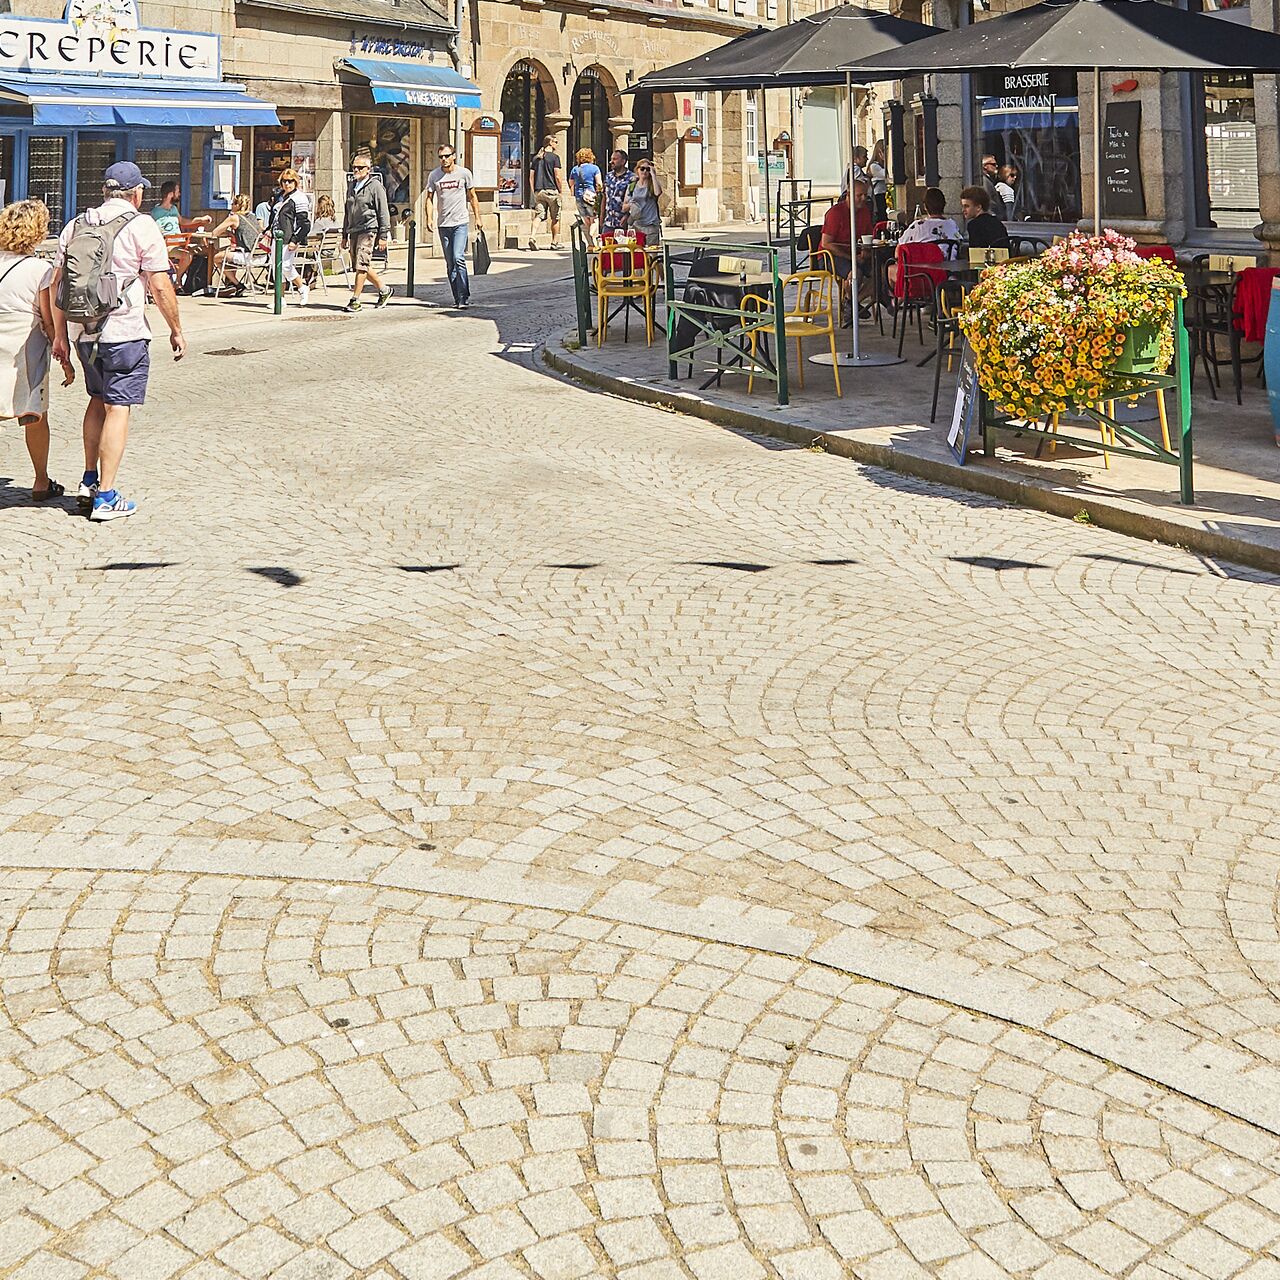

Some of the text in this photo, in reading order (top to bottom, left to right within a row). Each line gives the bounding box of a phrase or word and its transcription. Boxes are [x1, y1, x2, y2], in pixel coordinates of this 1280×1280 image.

[571, 29, 621, 57] Restaurant
[1004, 72, 1050, 90] BRASSERIE
[999, 93, 1057, 110] RESTAURANT
